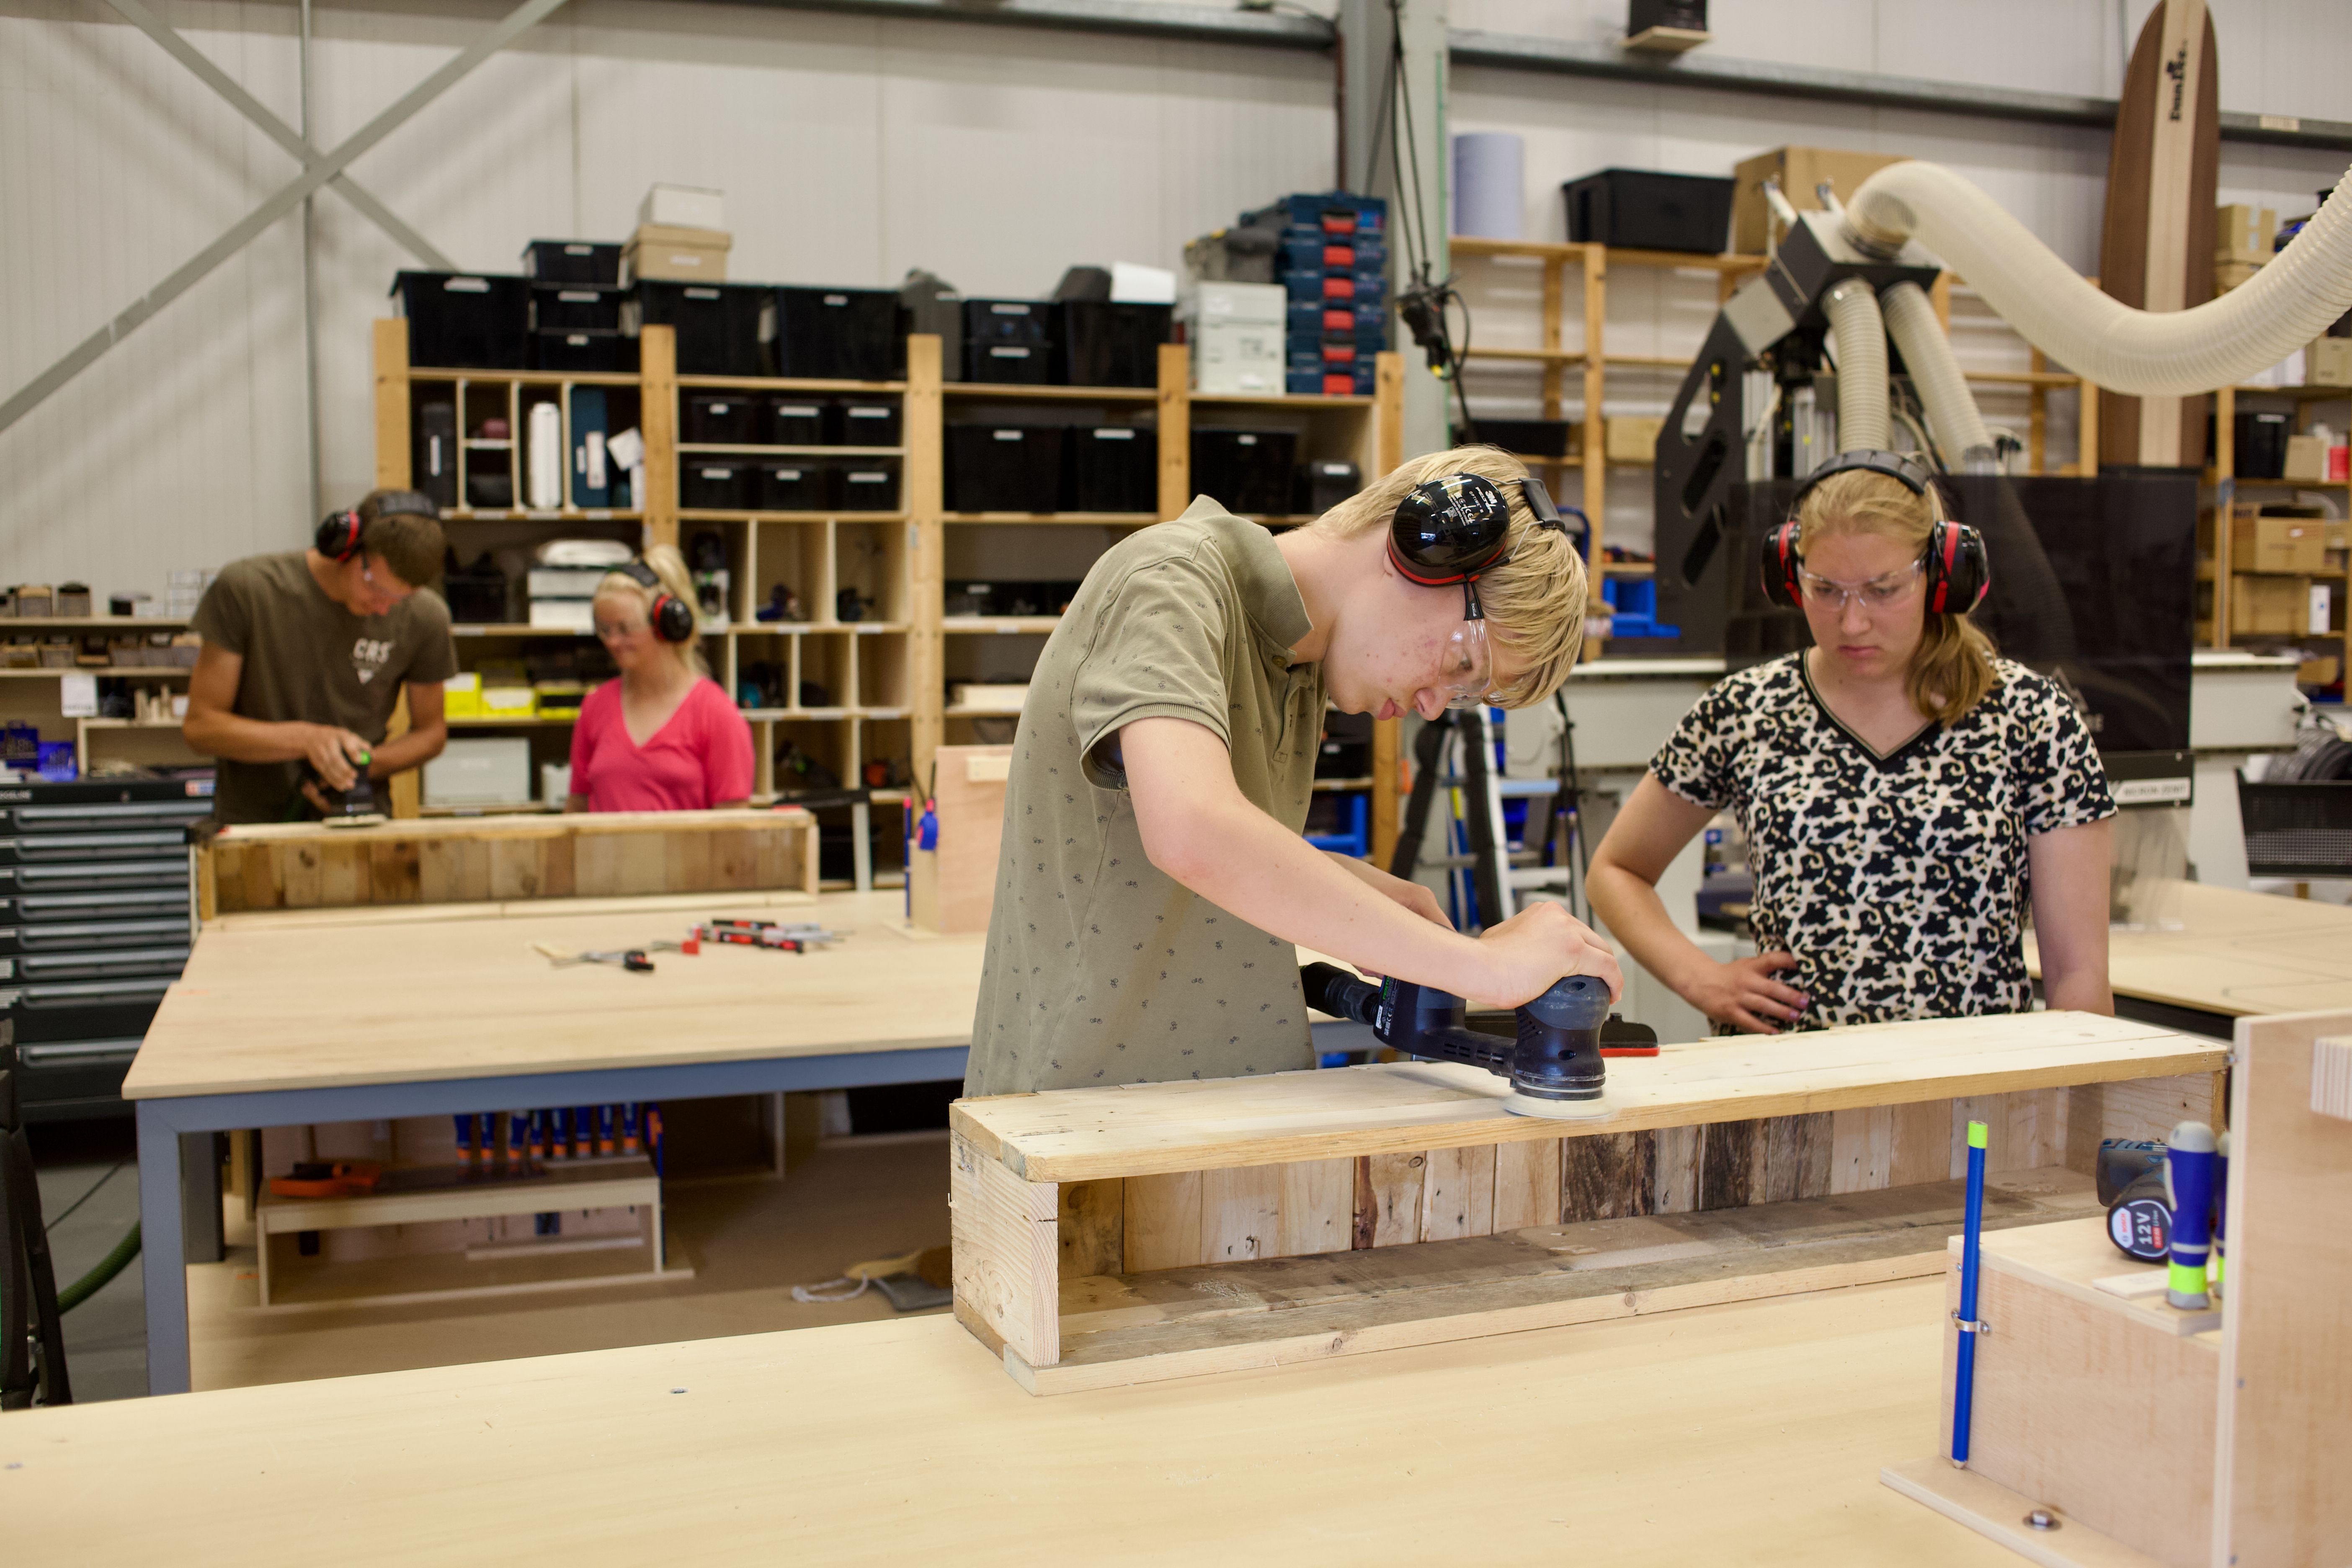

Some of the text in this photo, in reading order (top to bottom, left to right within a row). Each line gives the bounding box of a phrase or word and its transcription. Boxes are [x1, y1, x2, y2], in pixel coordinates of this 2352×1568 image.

[1475, 487, 1493, 513] PELTOR
[1485, 490, 1498, 504] 3M
[1422, 491, 1457, 545] PELTOR
[2136, 1212, 2153, 1245] 12V
